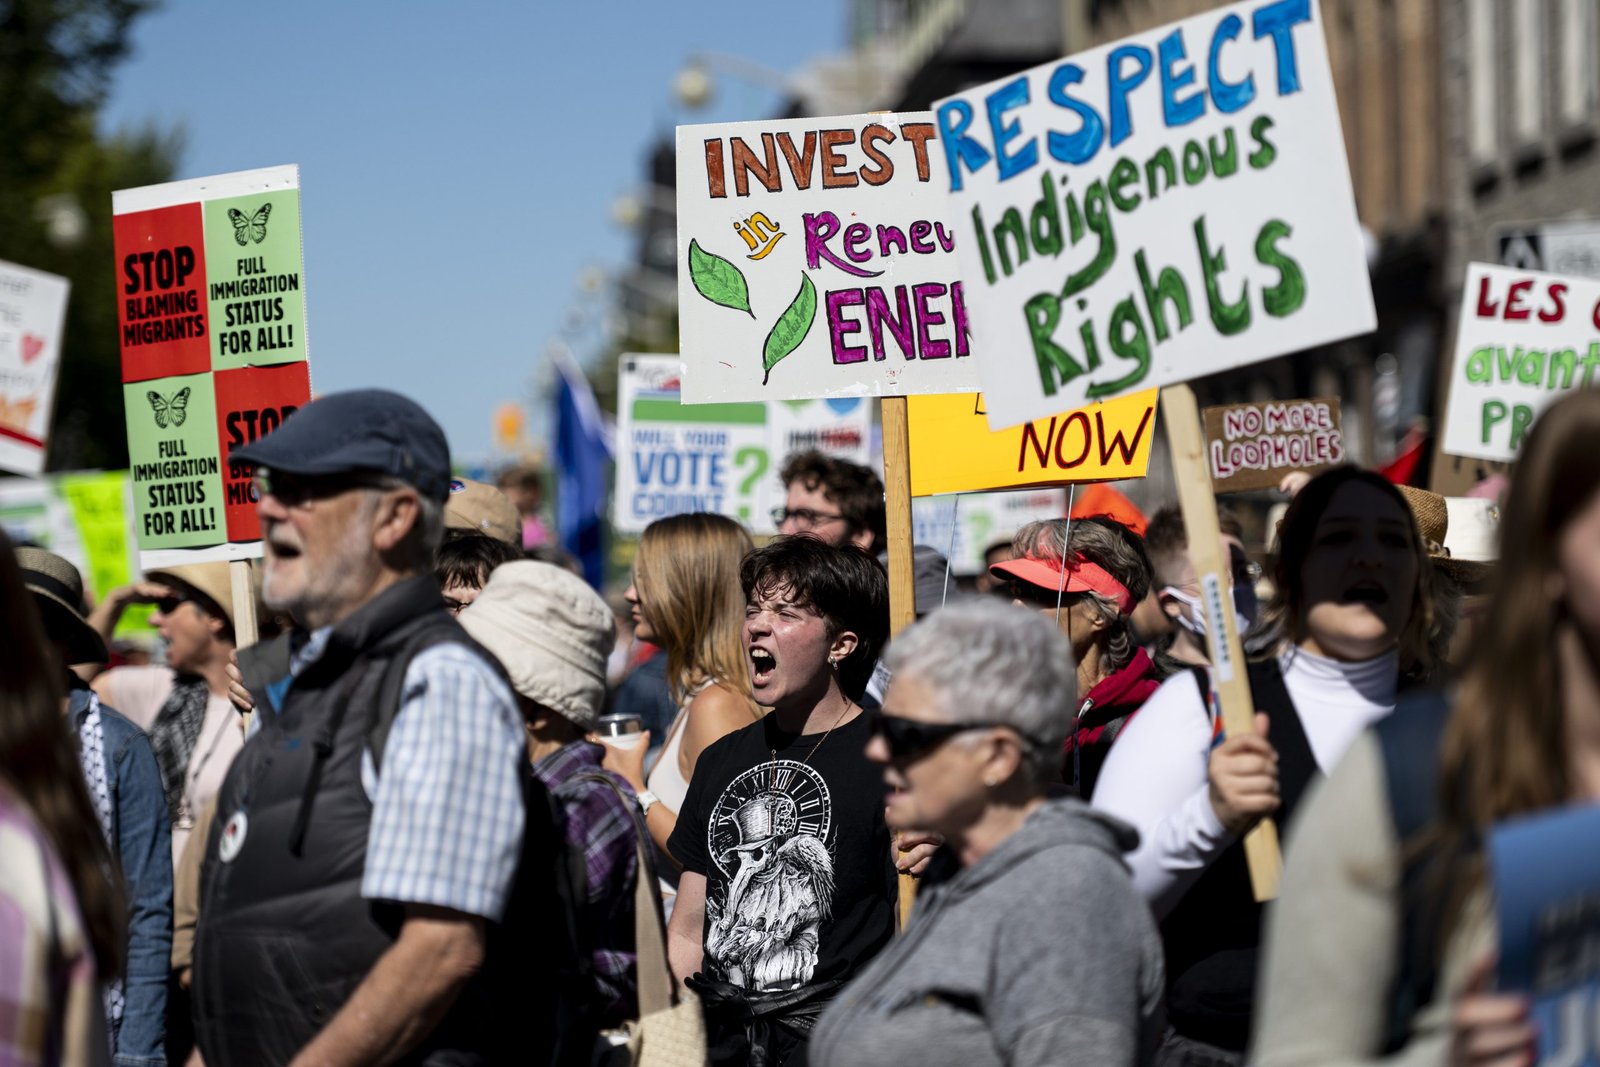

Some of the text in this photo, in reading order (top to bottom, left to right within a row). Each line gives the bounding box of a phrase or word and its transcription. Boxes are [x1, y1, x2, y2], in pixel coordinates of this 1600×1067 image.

[937, 0, 1312, 192] RESPECT
[704, 122, 936, 198] INVEST
[971, 115, 1277, 299] Indigenous
[734, 211, 786, 260] in
[124, 246, 195, 295] STOP
[237, 256, 266, 276] FULL
[210, 273, 299, 300] IMMIGRATION
[1476, 277, 1569, 323] LES
[126, 290, 198, 321] BLAMING
[225, 298, 284, 327] STATUS
[1023, 214, 1307, 399] Rights
[124, 314, 205, 347] MIGRANTS
[219, 325, 293, 355] FOR ALL!
[1018, 407, 1153, 472] NOW
[1223, 402, 1333, 441] NO MORE
[158, 439, 187, 458] FULL
[1211, 430, 1344, 479] LOOPHOLES
[133, 457, 218, 482] IMMIGRATION
[634, 451, 724, 487] VOTE
[148, 480, 205, 508] STATUS
[143, 507, 216, 536] FOR ALL!
